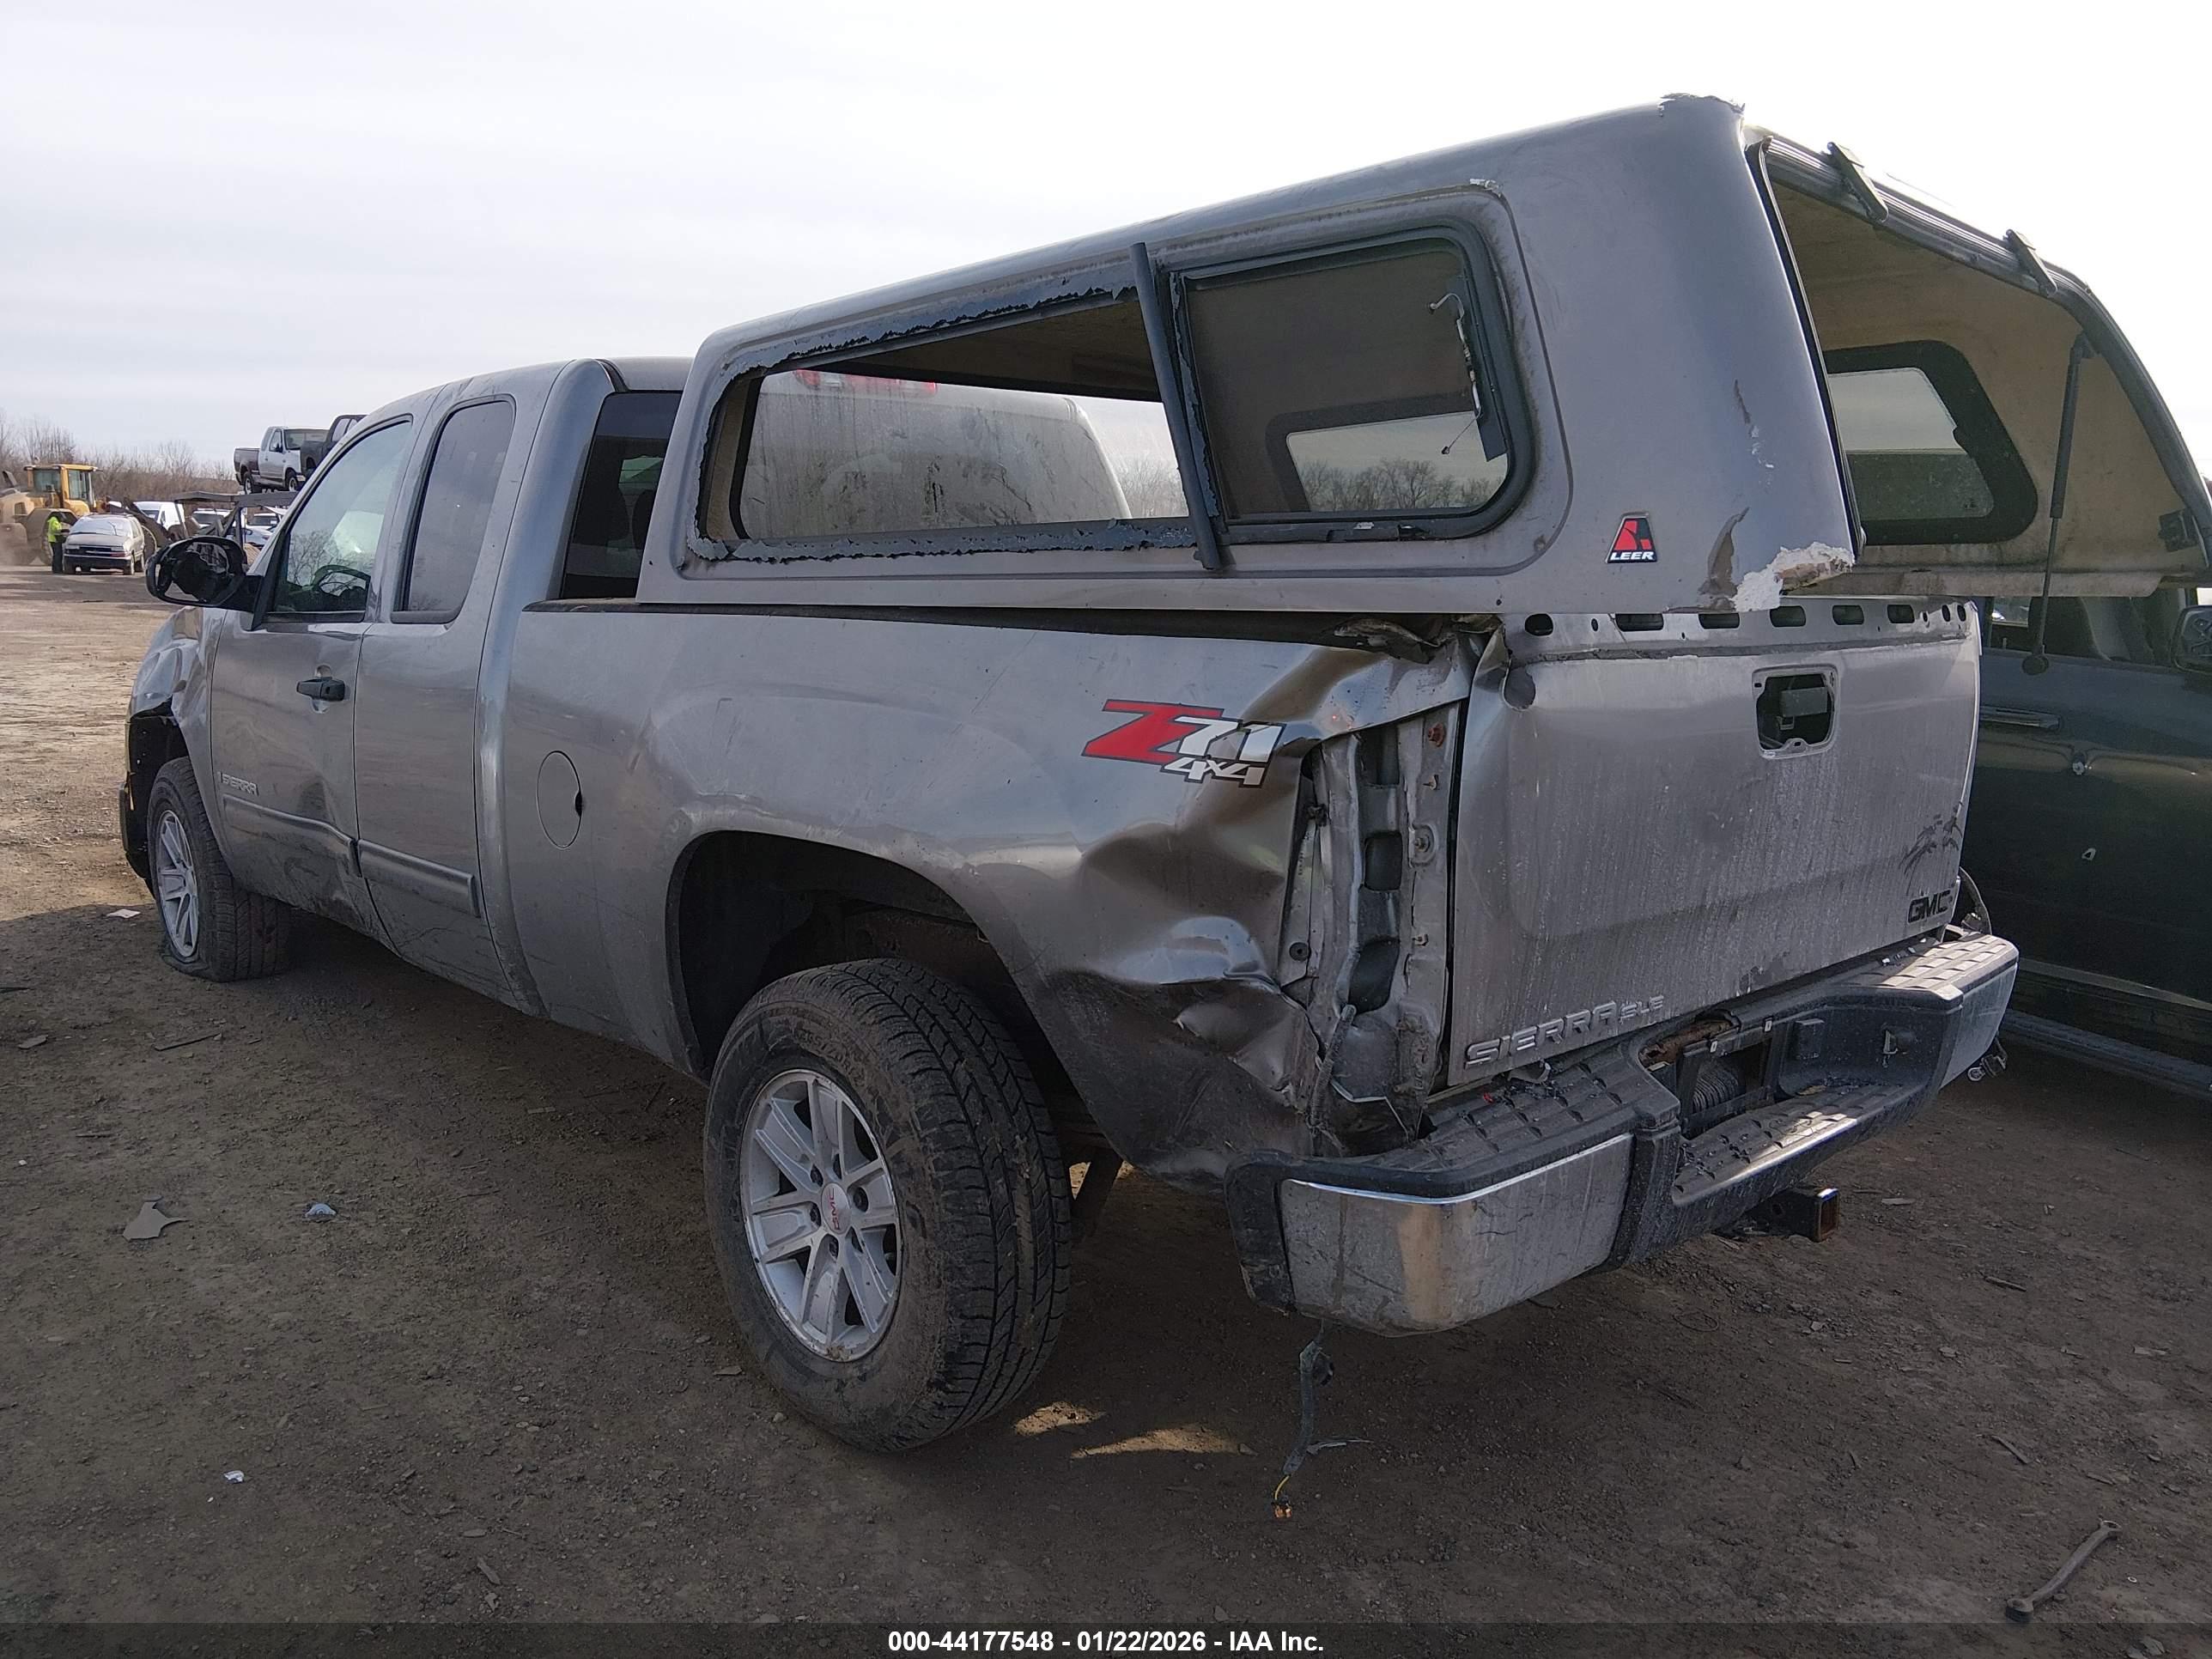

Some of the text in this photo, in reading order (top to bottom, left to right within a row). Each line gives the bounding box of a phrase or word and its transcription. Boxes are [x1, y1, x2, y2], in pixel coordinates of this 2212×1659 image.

[1609, 550, 1655, 562] LEER
[1081, 698, 1287, 765] Z71
[1907, 889, 1953, 924] GMC
[1464, 994, 1665, 1070] SIERRA SLE
[829, 1188, 842, 1231] GMC
